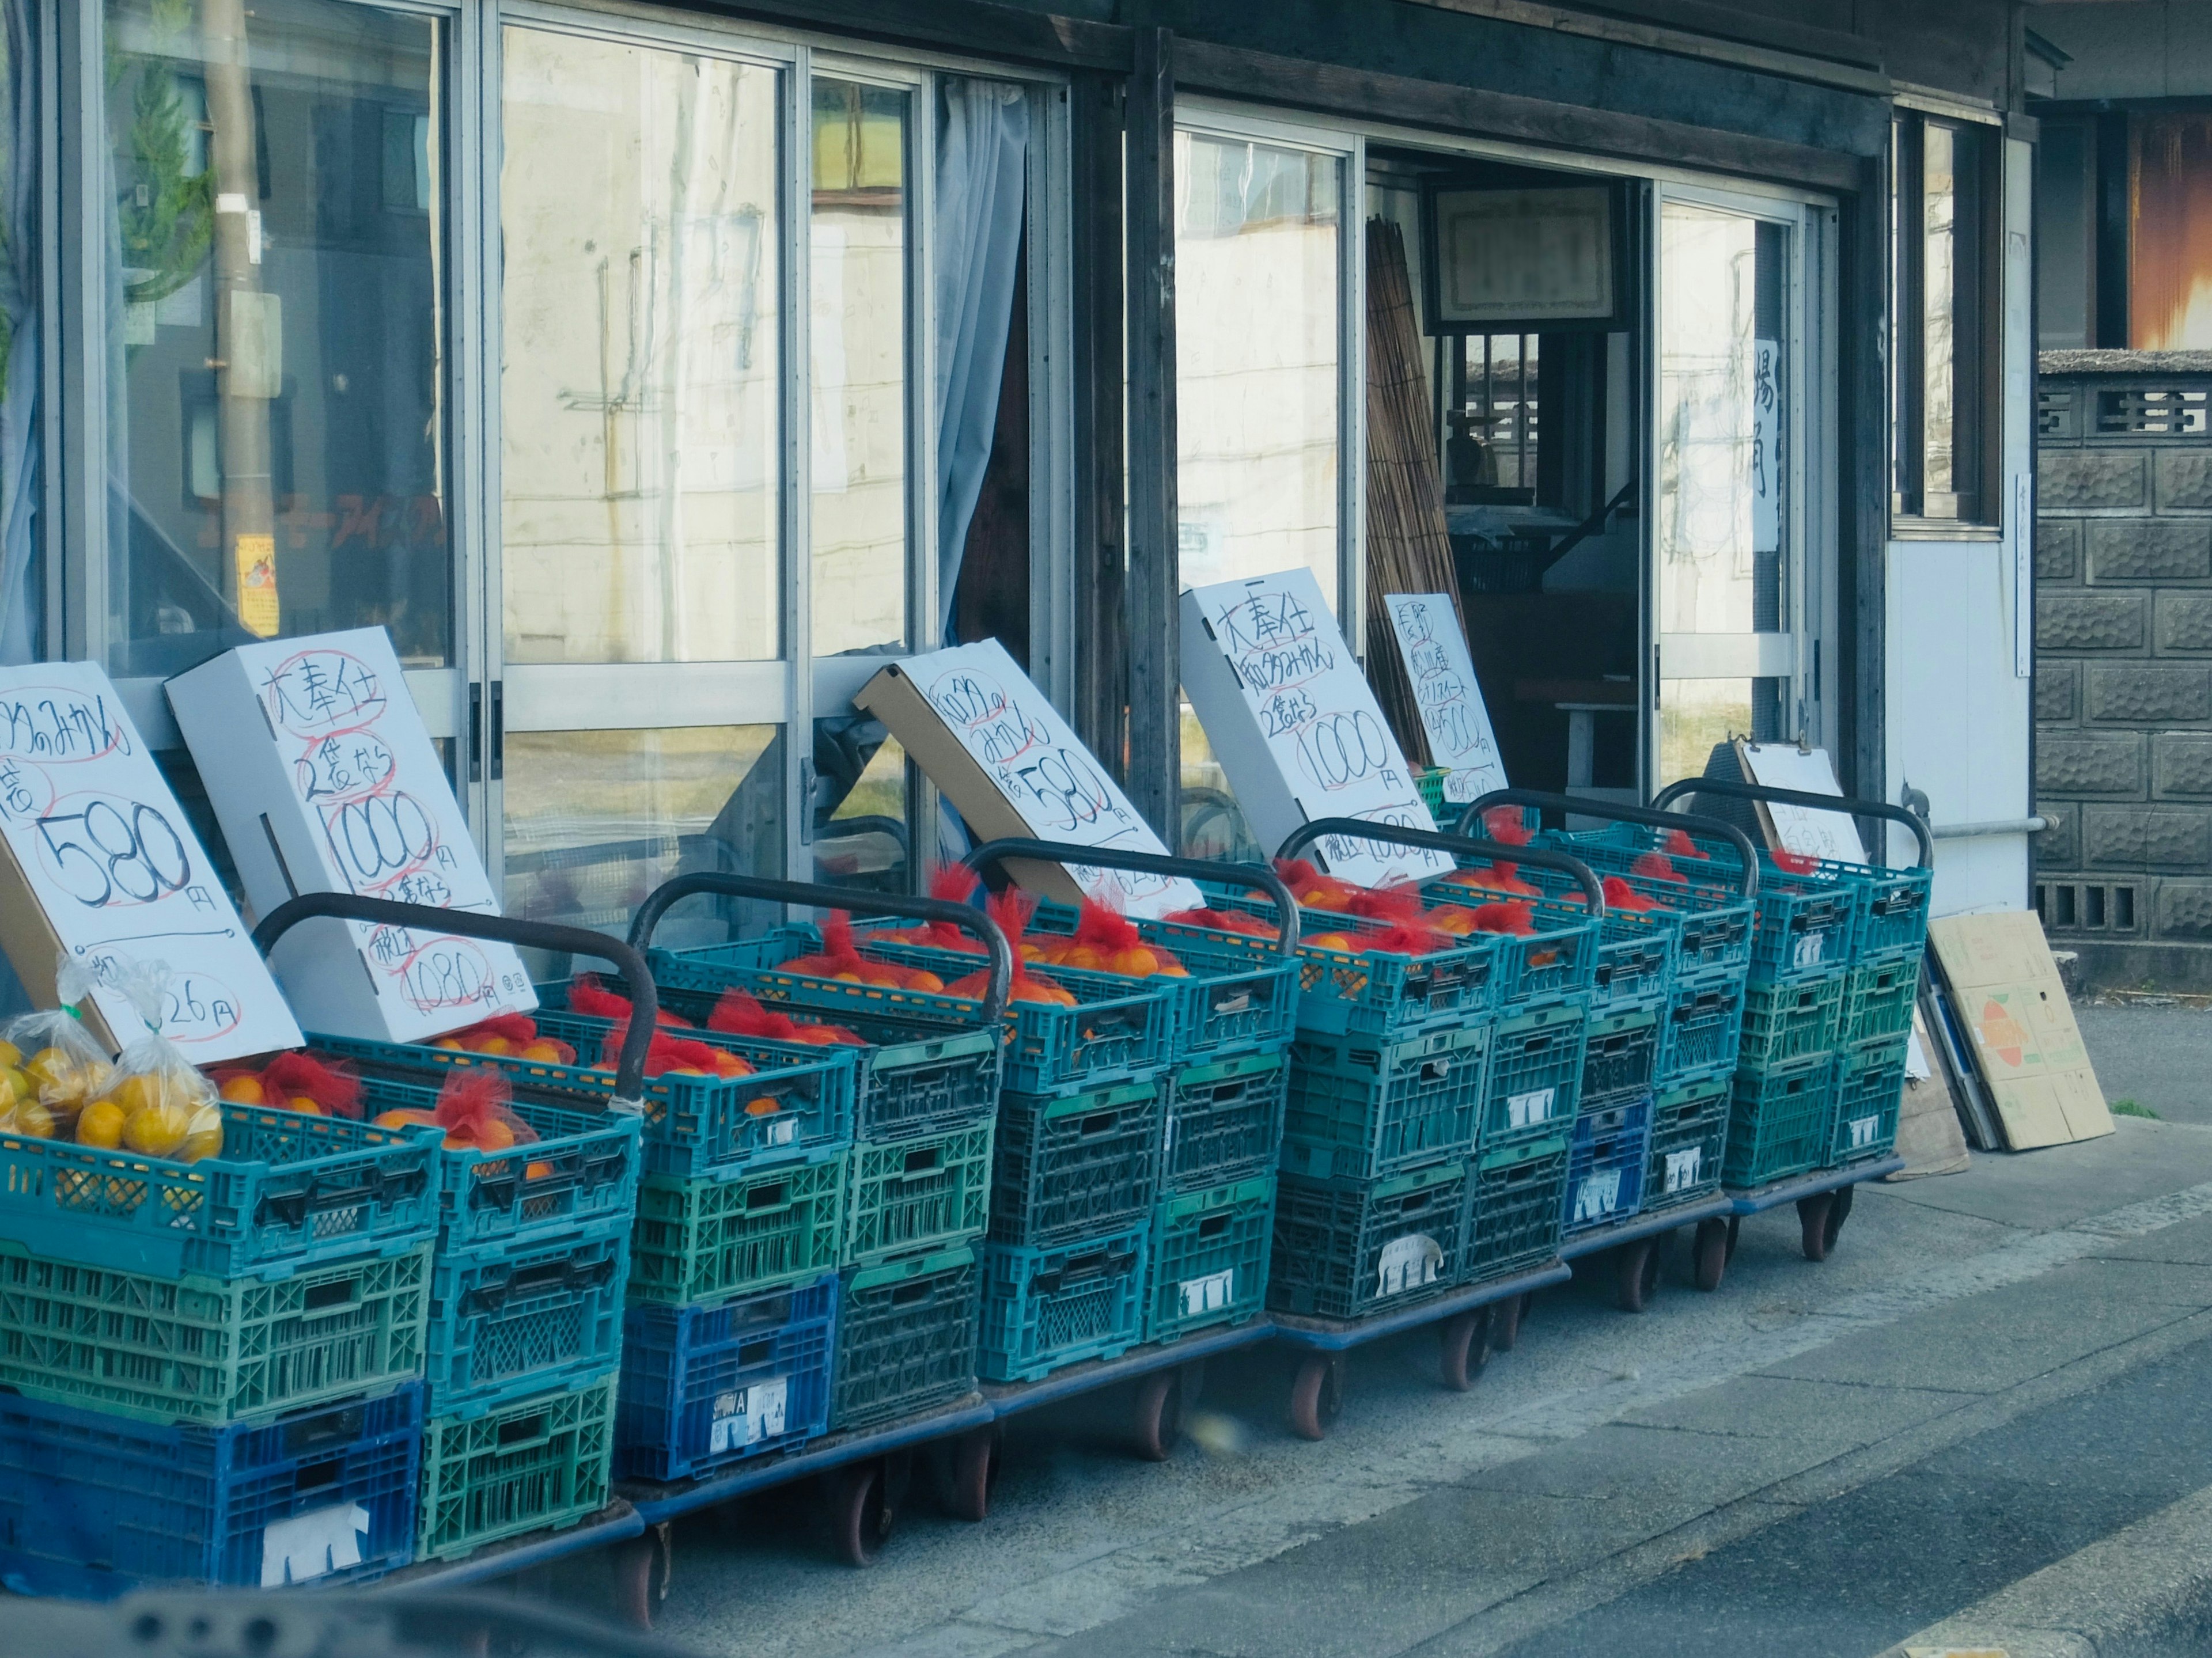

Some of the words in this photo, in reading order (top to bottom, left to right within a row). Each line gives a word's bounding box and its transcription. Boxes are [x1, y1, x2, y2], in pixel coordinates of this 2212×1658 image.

[1218, 591, 1315, 653] 大奉仕
[261, 658, 387, 726] 大奉仕
[971, 699, 1051, 764] みかん
[294, 737, 393, 802] 2袋なら
[36, 800, 217, 912] 580円
[369, 926, 418, 964] 税込
